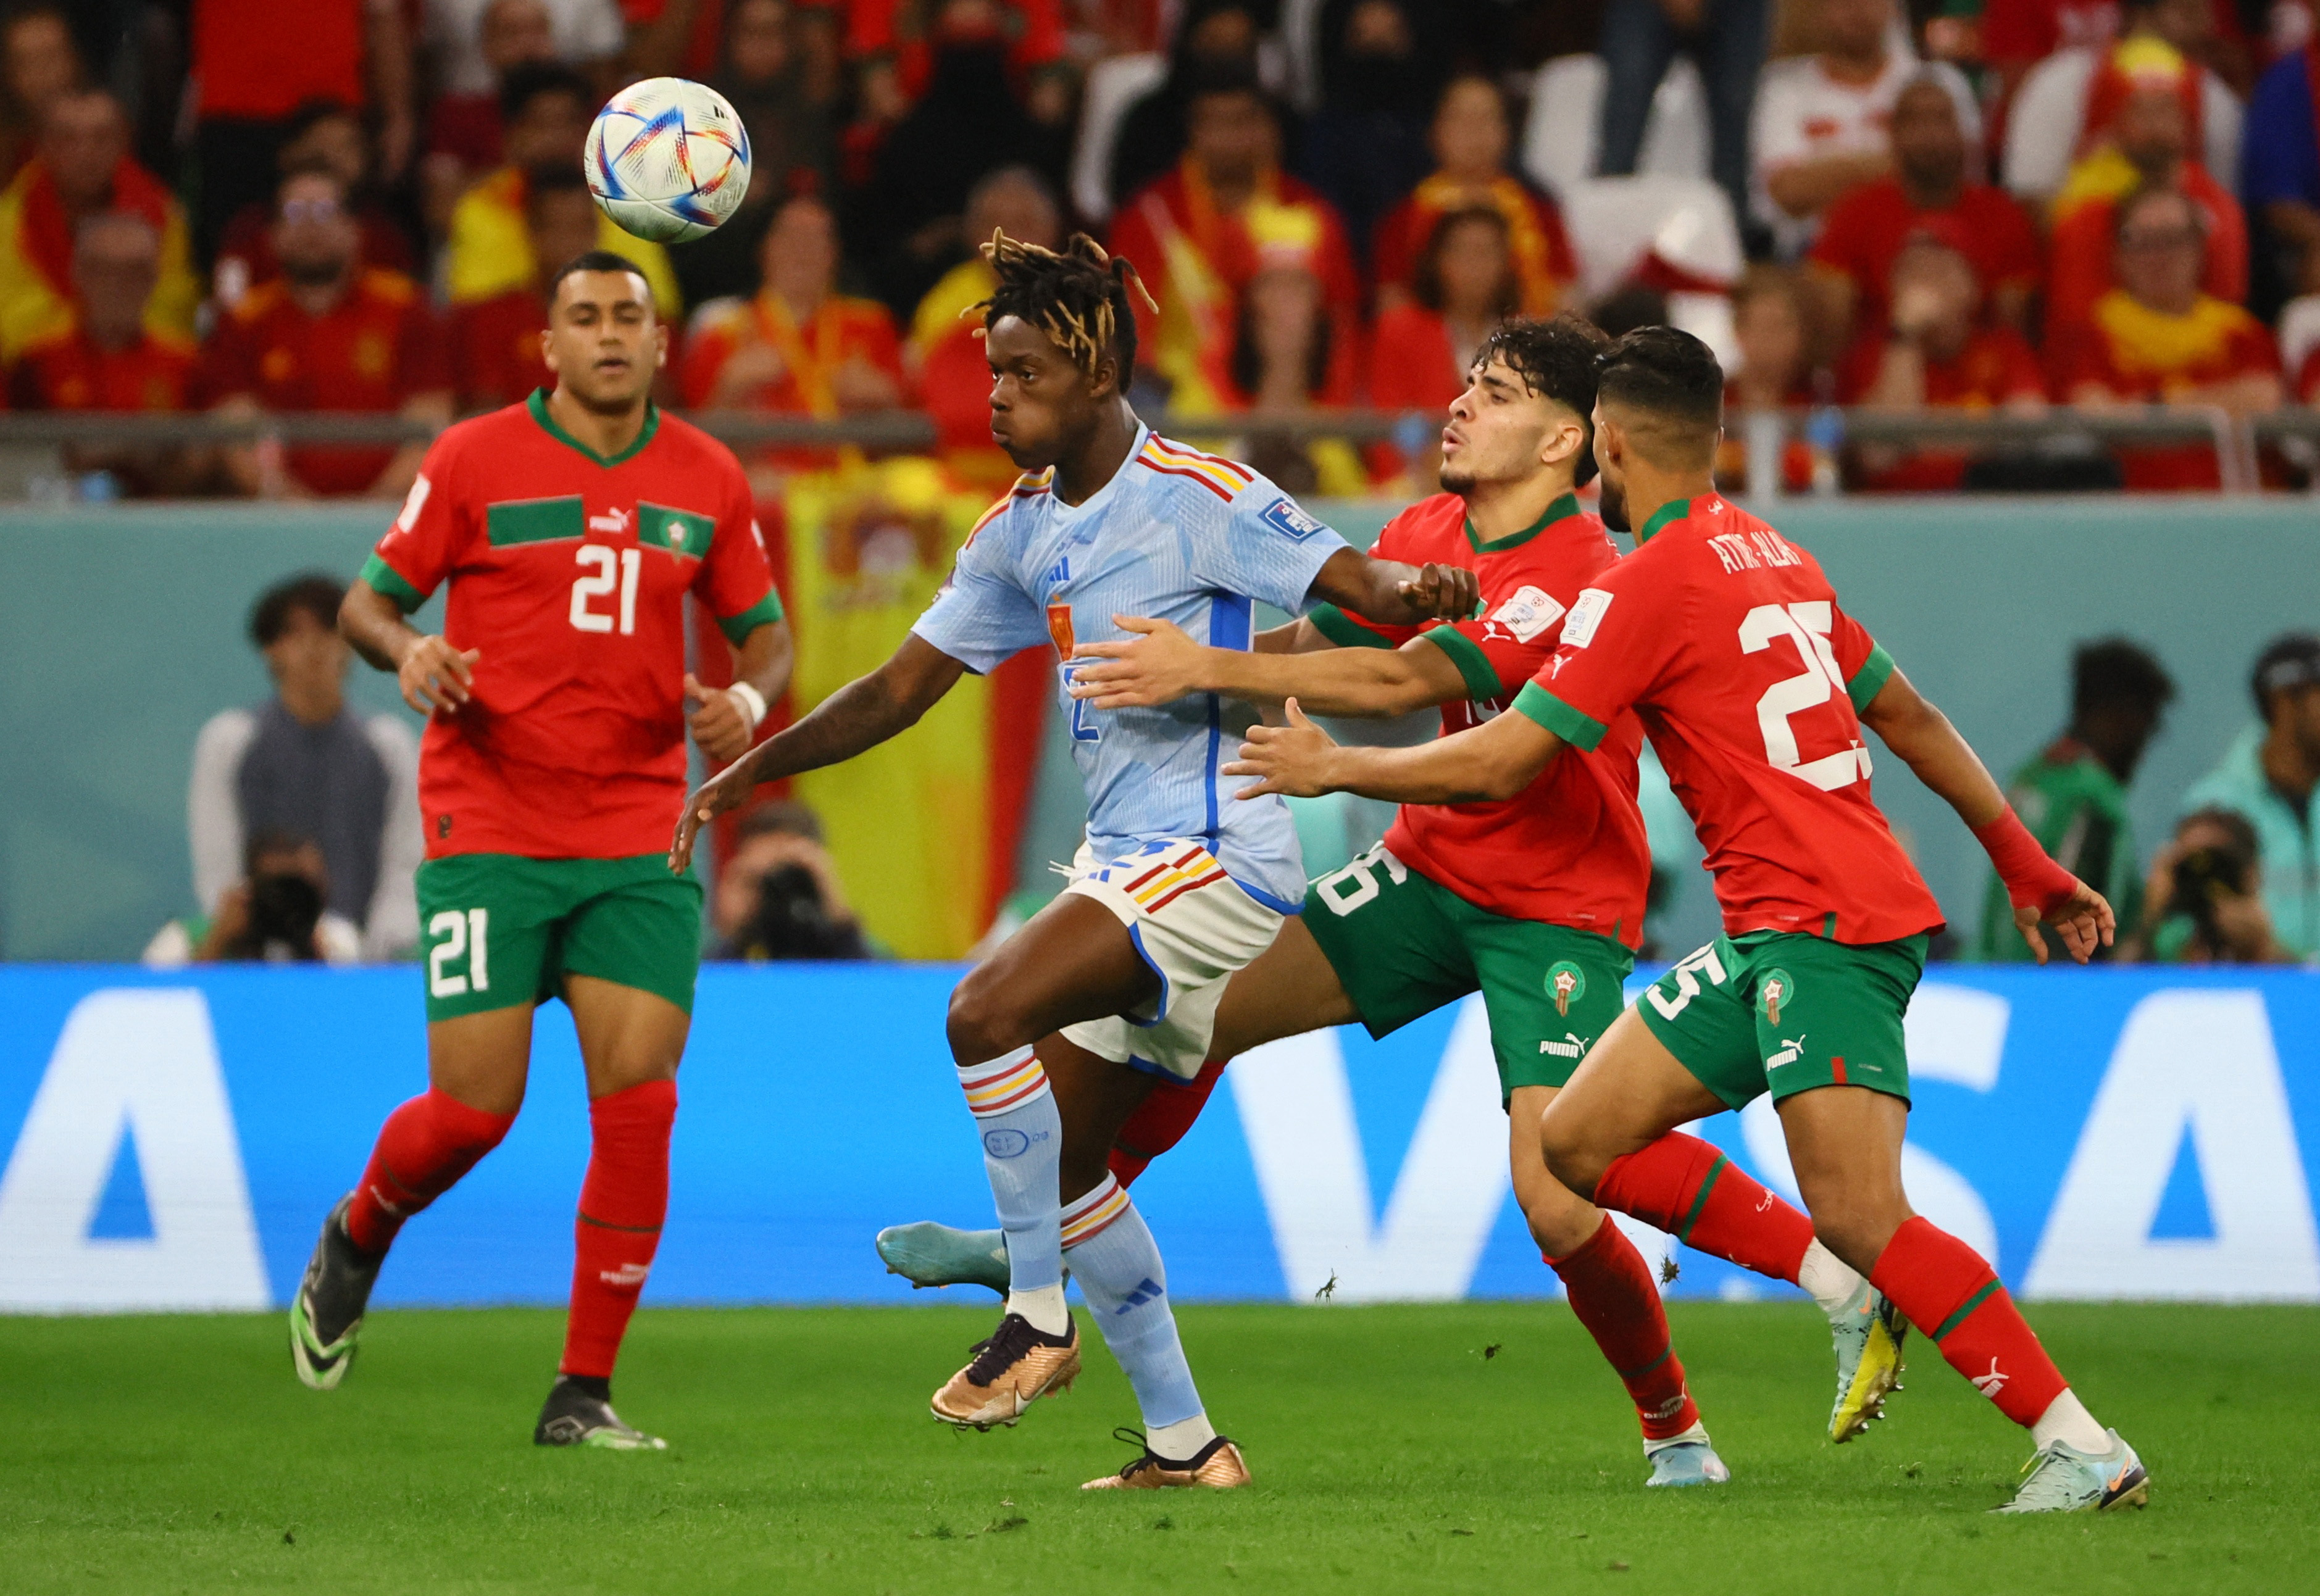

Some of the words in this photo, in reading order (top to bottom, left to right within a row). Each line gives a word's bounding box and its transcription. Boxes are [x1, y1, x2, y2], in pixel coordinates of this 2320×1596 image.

[569, 544, 641, 635] 21
[1738, 601, 1873, 792] 25
[1308, 840, 1407, 917] 6
[428, 908, 488, 998] 21
[1540, 1041, 1579, 1058] PUMA
[1767, 1048, 1797, 1071] PUMA
[1225, 983, 2319, 1305] VSA
